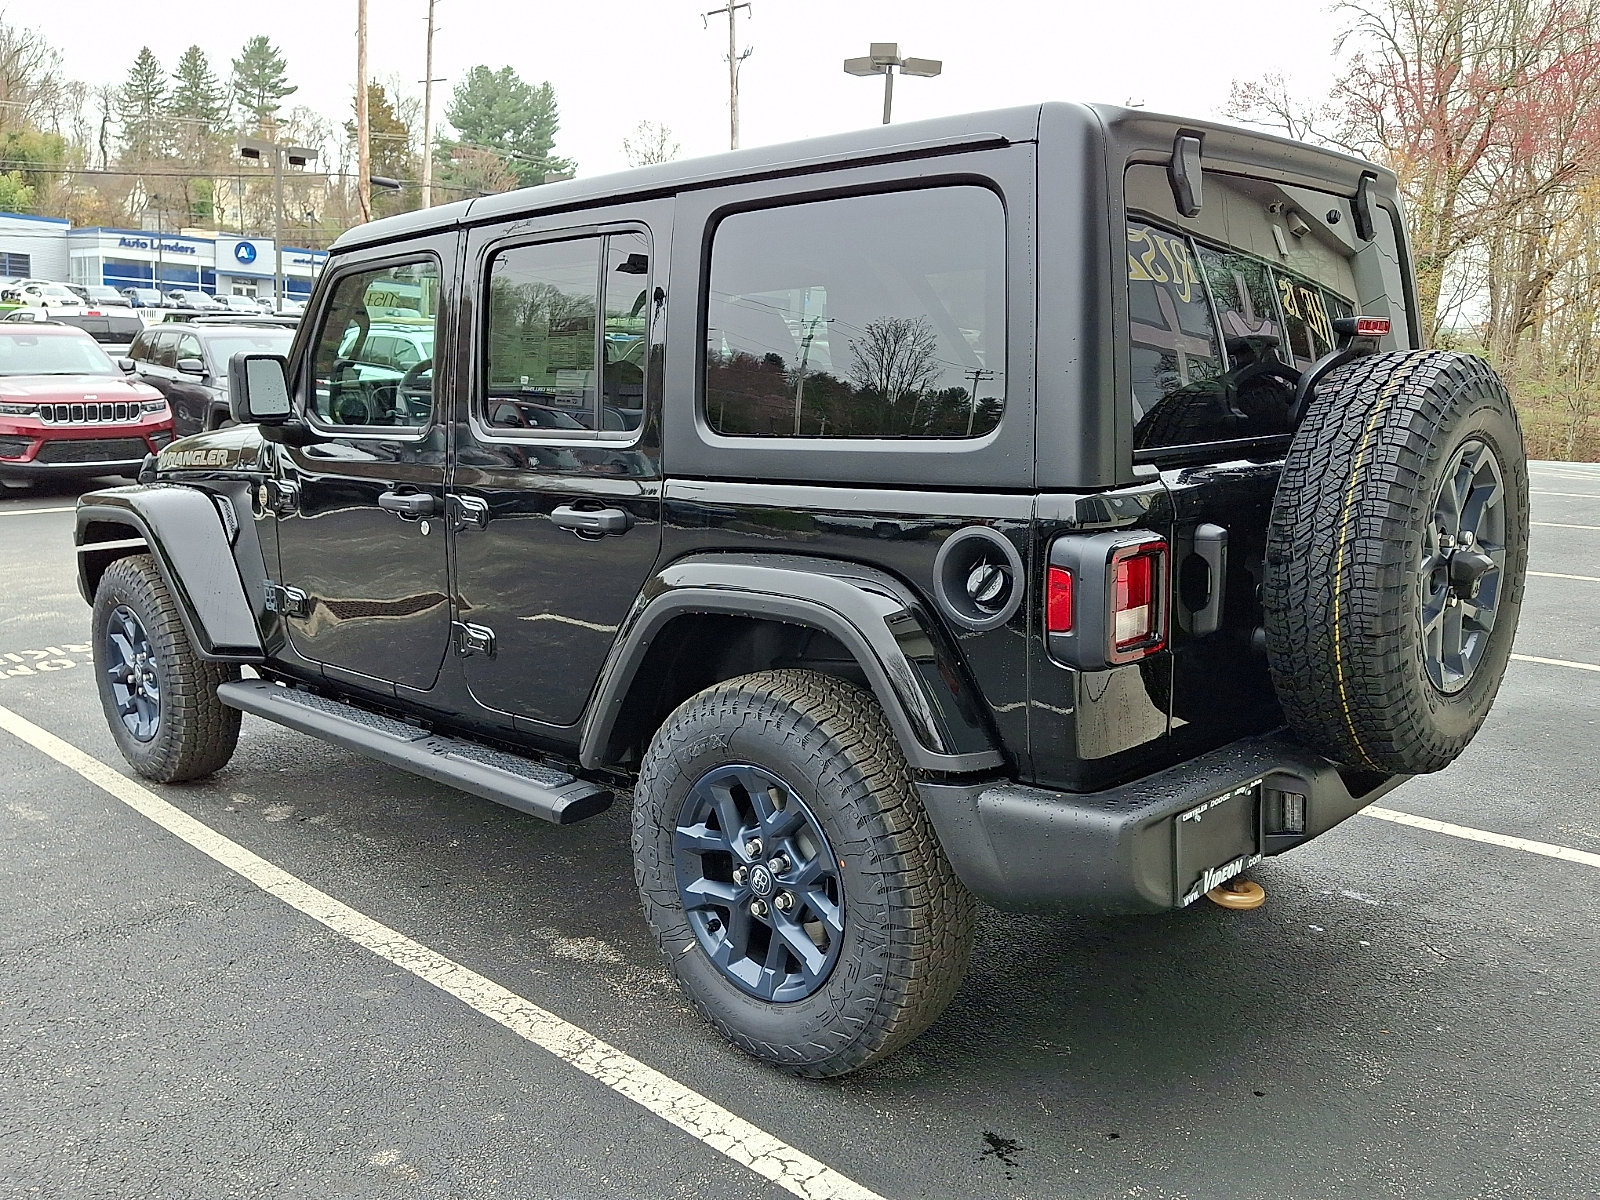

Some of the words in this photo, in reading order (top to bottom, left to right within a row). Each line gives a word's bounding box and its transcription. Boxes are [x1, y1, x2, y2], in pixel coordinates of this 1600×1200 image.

[119, 236, 148, 249] Auto
[158, 449, 229, 467] WRANGLER
[1210, 793, 1231, 808] DODGE
